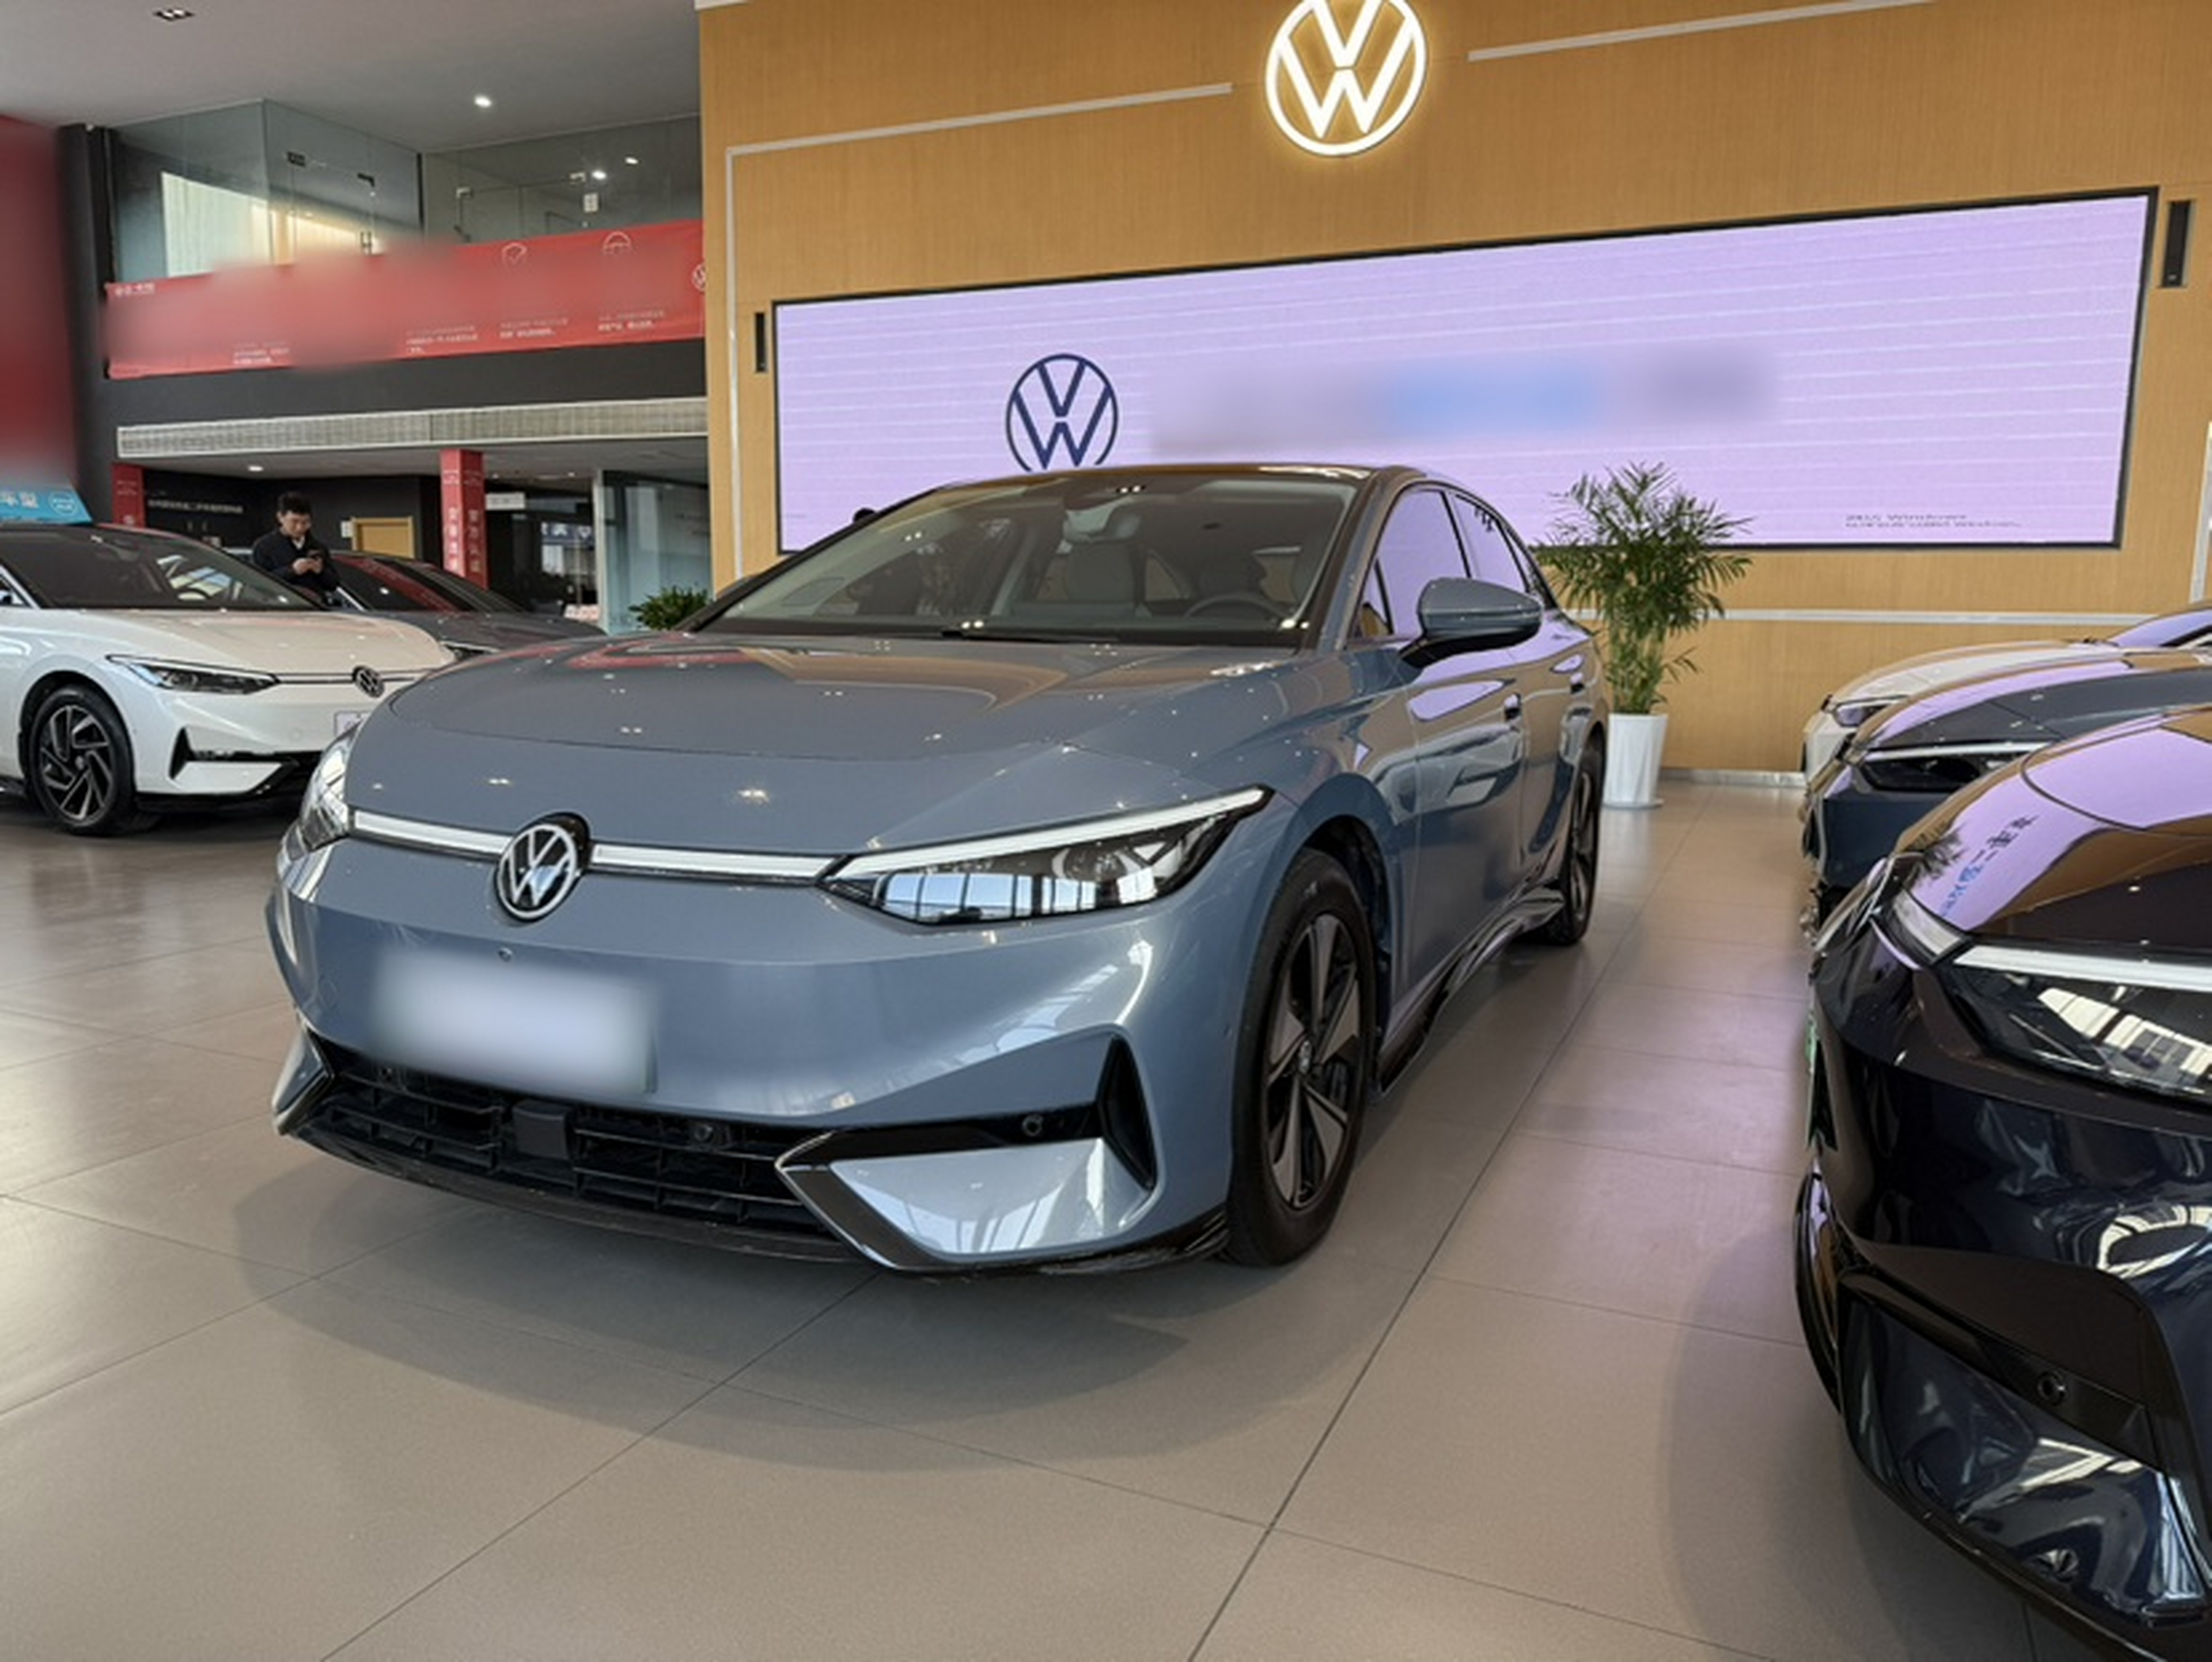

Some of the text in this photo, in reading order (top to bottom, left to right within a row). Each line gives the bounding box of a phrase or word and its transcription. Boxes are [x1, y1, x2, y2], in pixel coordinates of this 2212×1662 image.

[1267, 0, 1426, 156] VW
[1007, 354, 1117, 470] VW
[498, 824, 576, 917] VW
